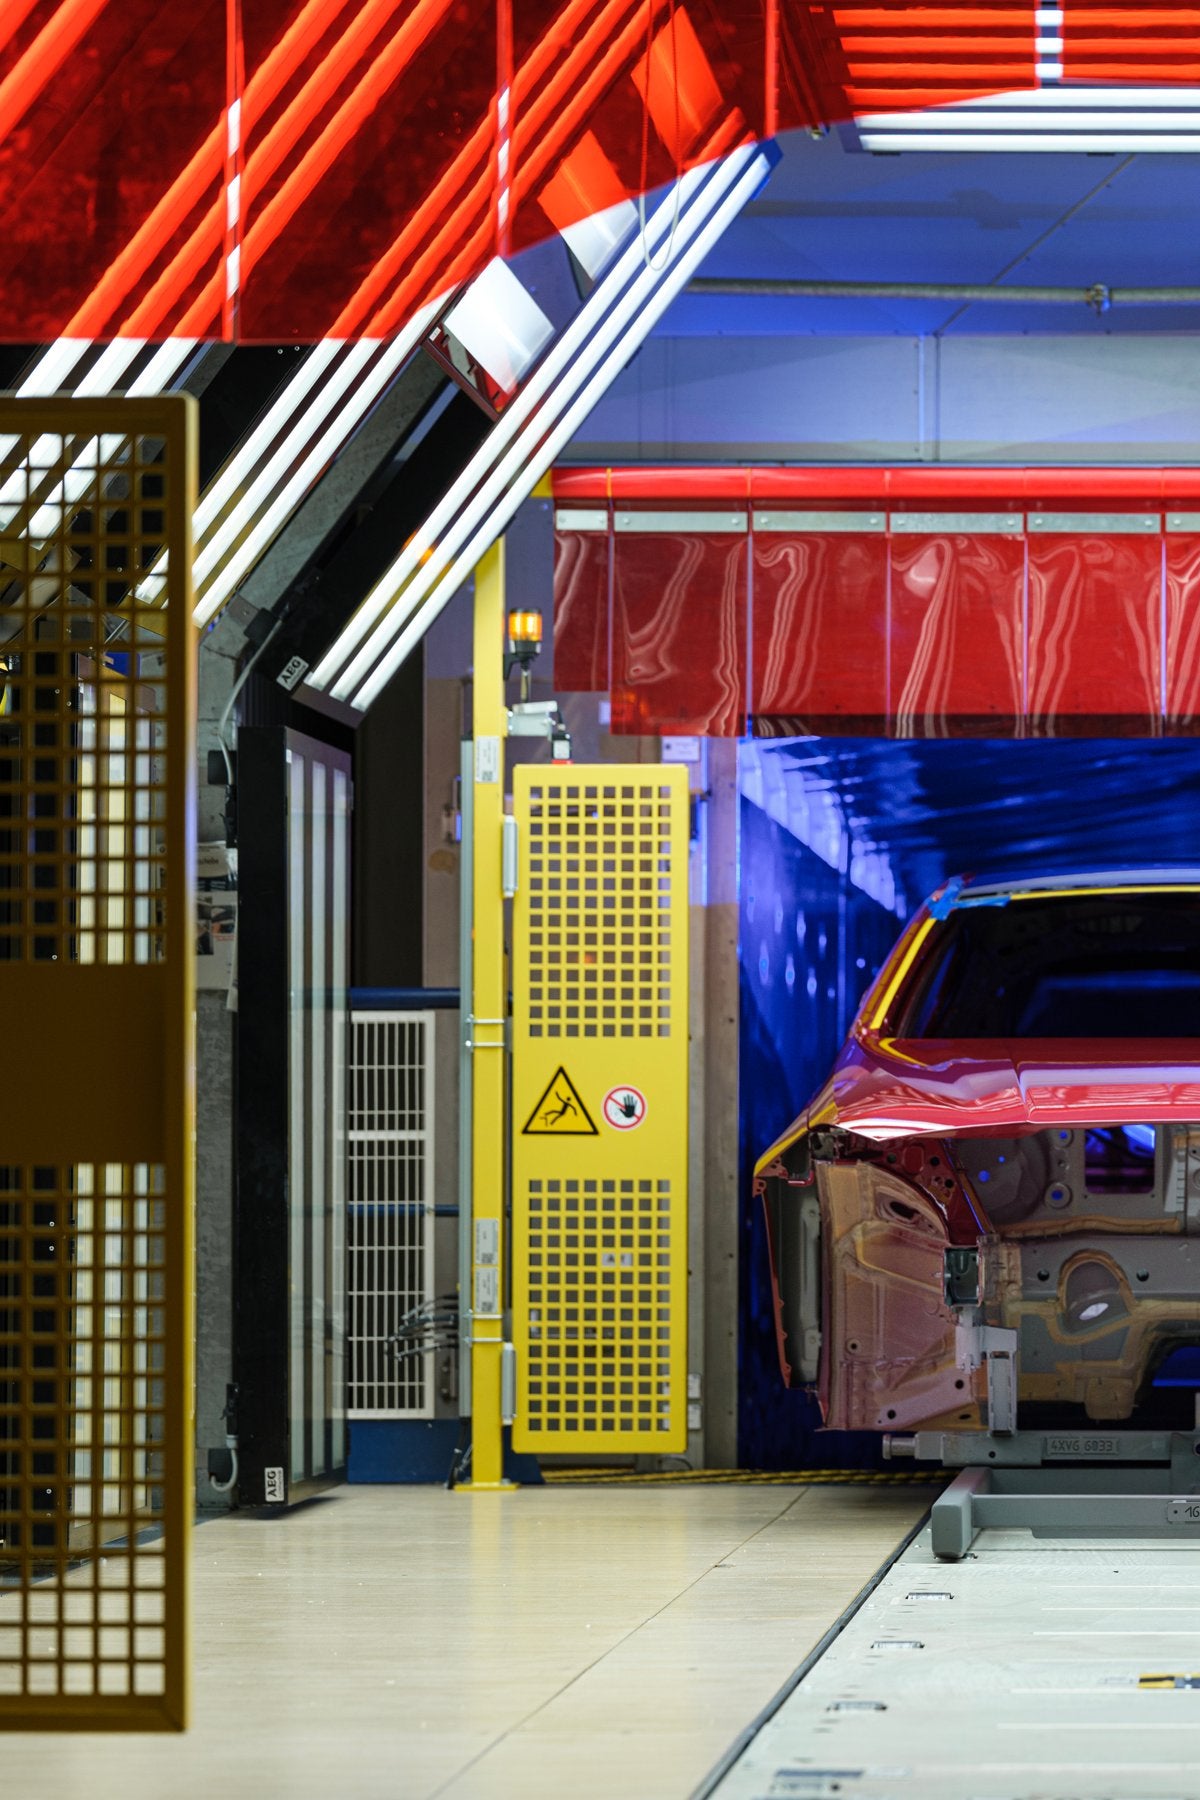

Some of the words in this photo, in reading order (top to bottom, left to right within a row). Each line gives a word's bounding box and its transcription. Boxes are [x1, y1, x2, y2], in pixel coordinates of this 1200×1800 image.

[281, 658, 301, 684] AEG
[1084, 1439, 1113, 1452] 6033
[267, 1470, 277, 1498] AEG
